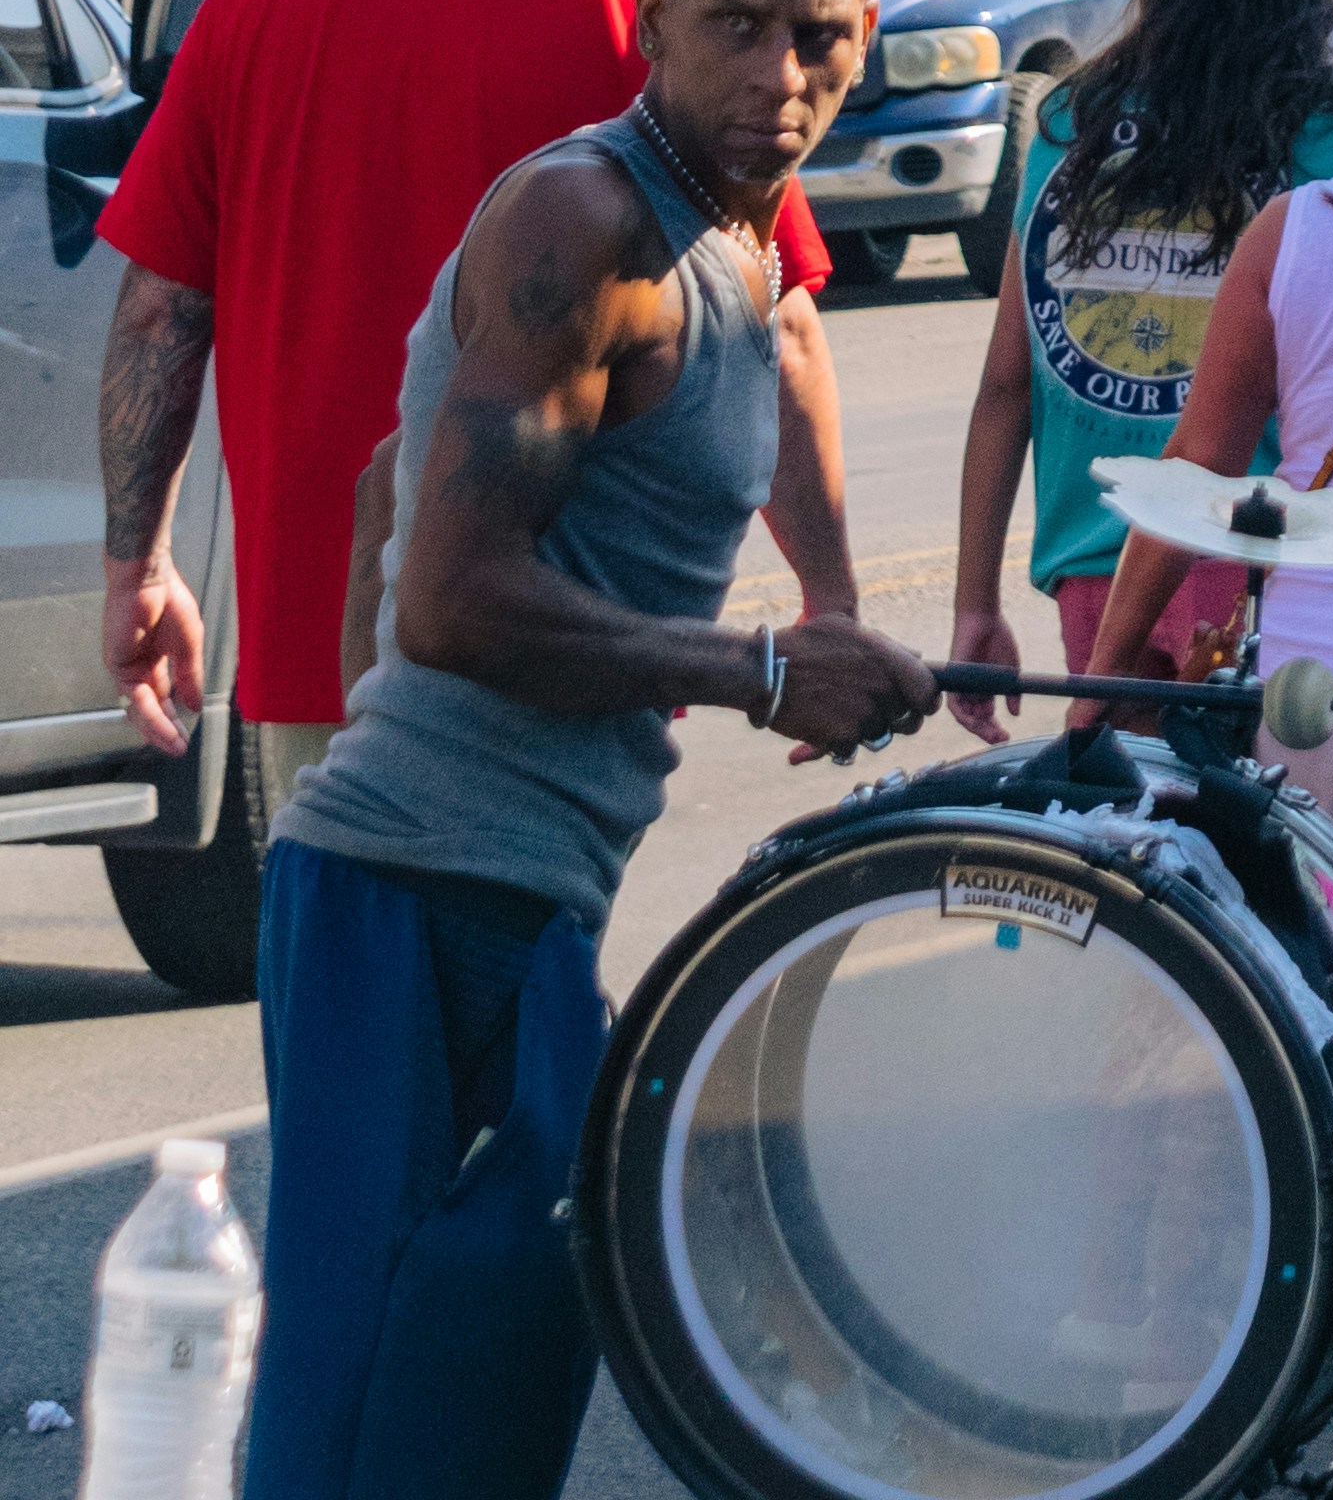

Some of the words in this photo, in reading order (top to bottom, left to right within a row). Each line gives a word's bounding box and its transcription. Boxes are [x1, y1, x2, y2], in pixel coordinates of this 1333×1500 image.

[1033, 298, 1082, 376] SAVE
[1086, 371, 1161, 412] OUR
[963, 893, 1012, 910] SUPER
[1017, 900, 1056, 920] KICK
[1058, 910, 1072, 927] II
